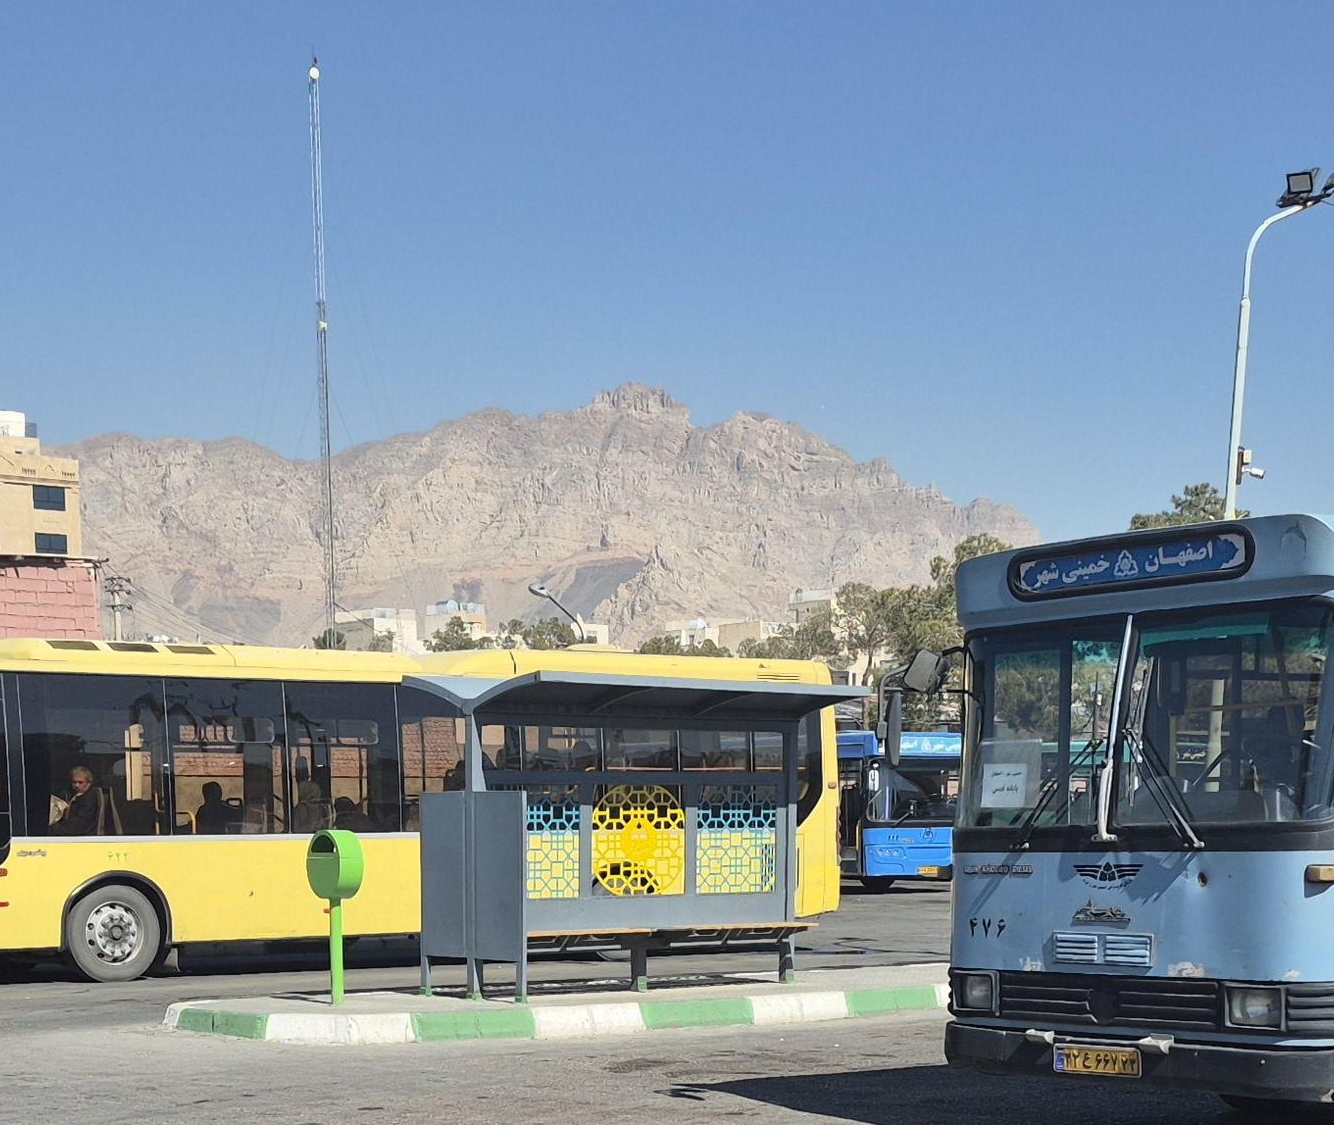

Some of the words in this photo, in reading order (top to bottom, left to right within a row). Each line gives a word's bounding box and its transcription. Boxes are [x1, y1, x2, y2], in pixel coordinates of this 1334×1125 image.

[1061, 554, 1111, 584] خمینی
[1145, 539, 1213, 573] اصفهان
[1034, 561, 1059, 589] شهر
[969, 916, 1007, 938] ۴۷۶
